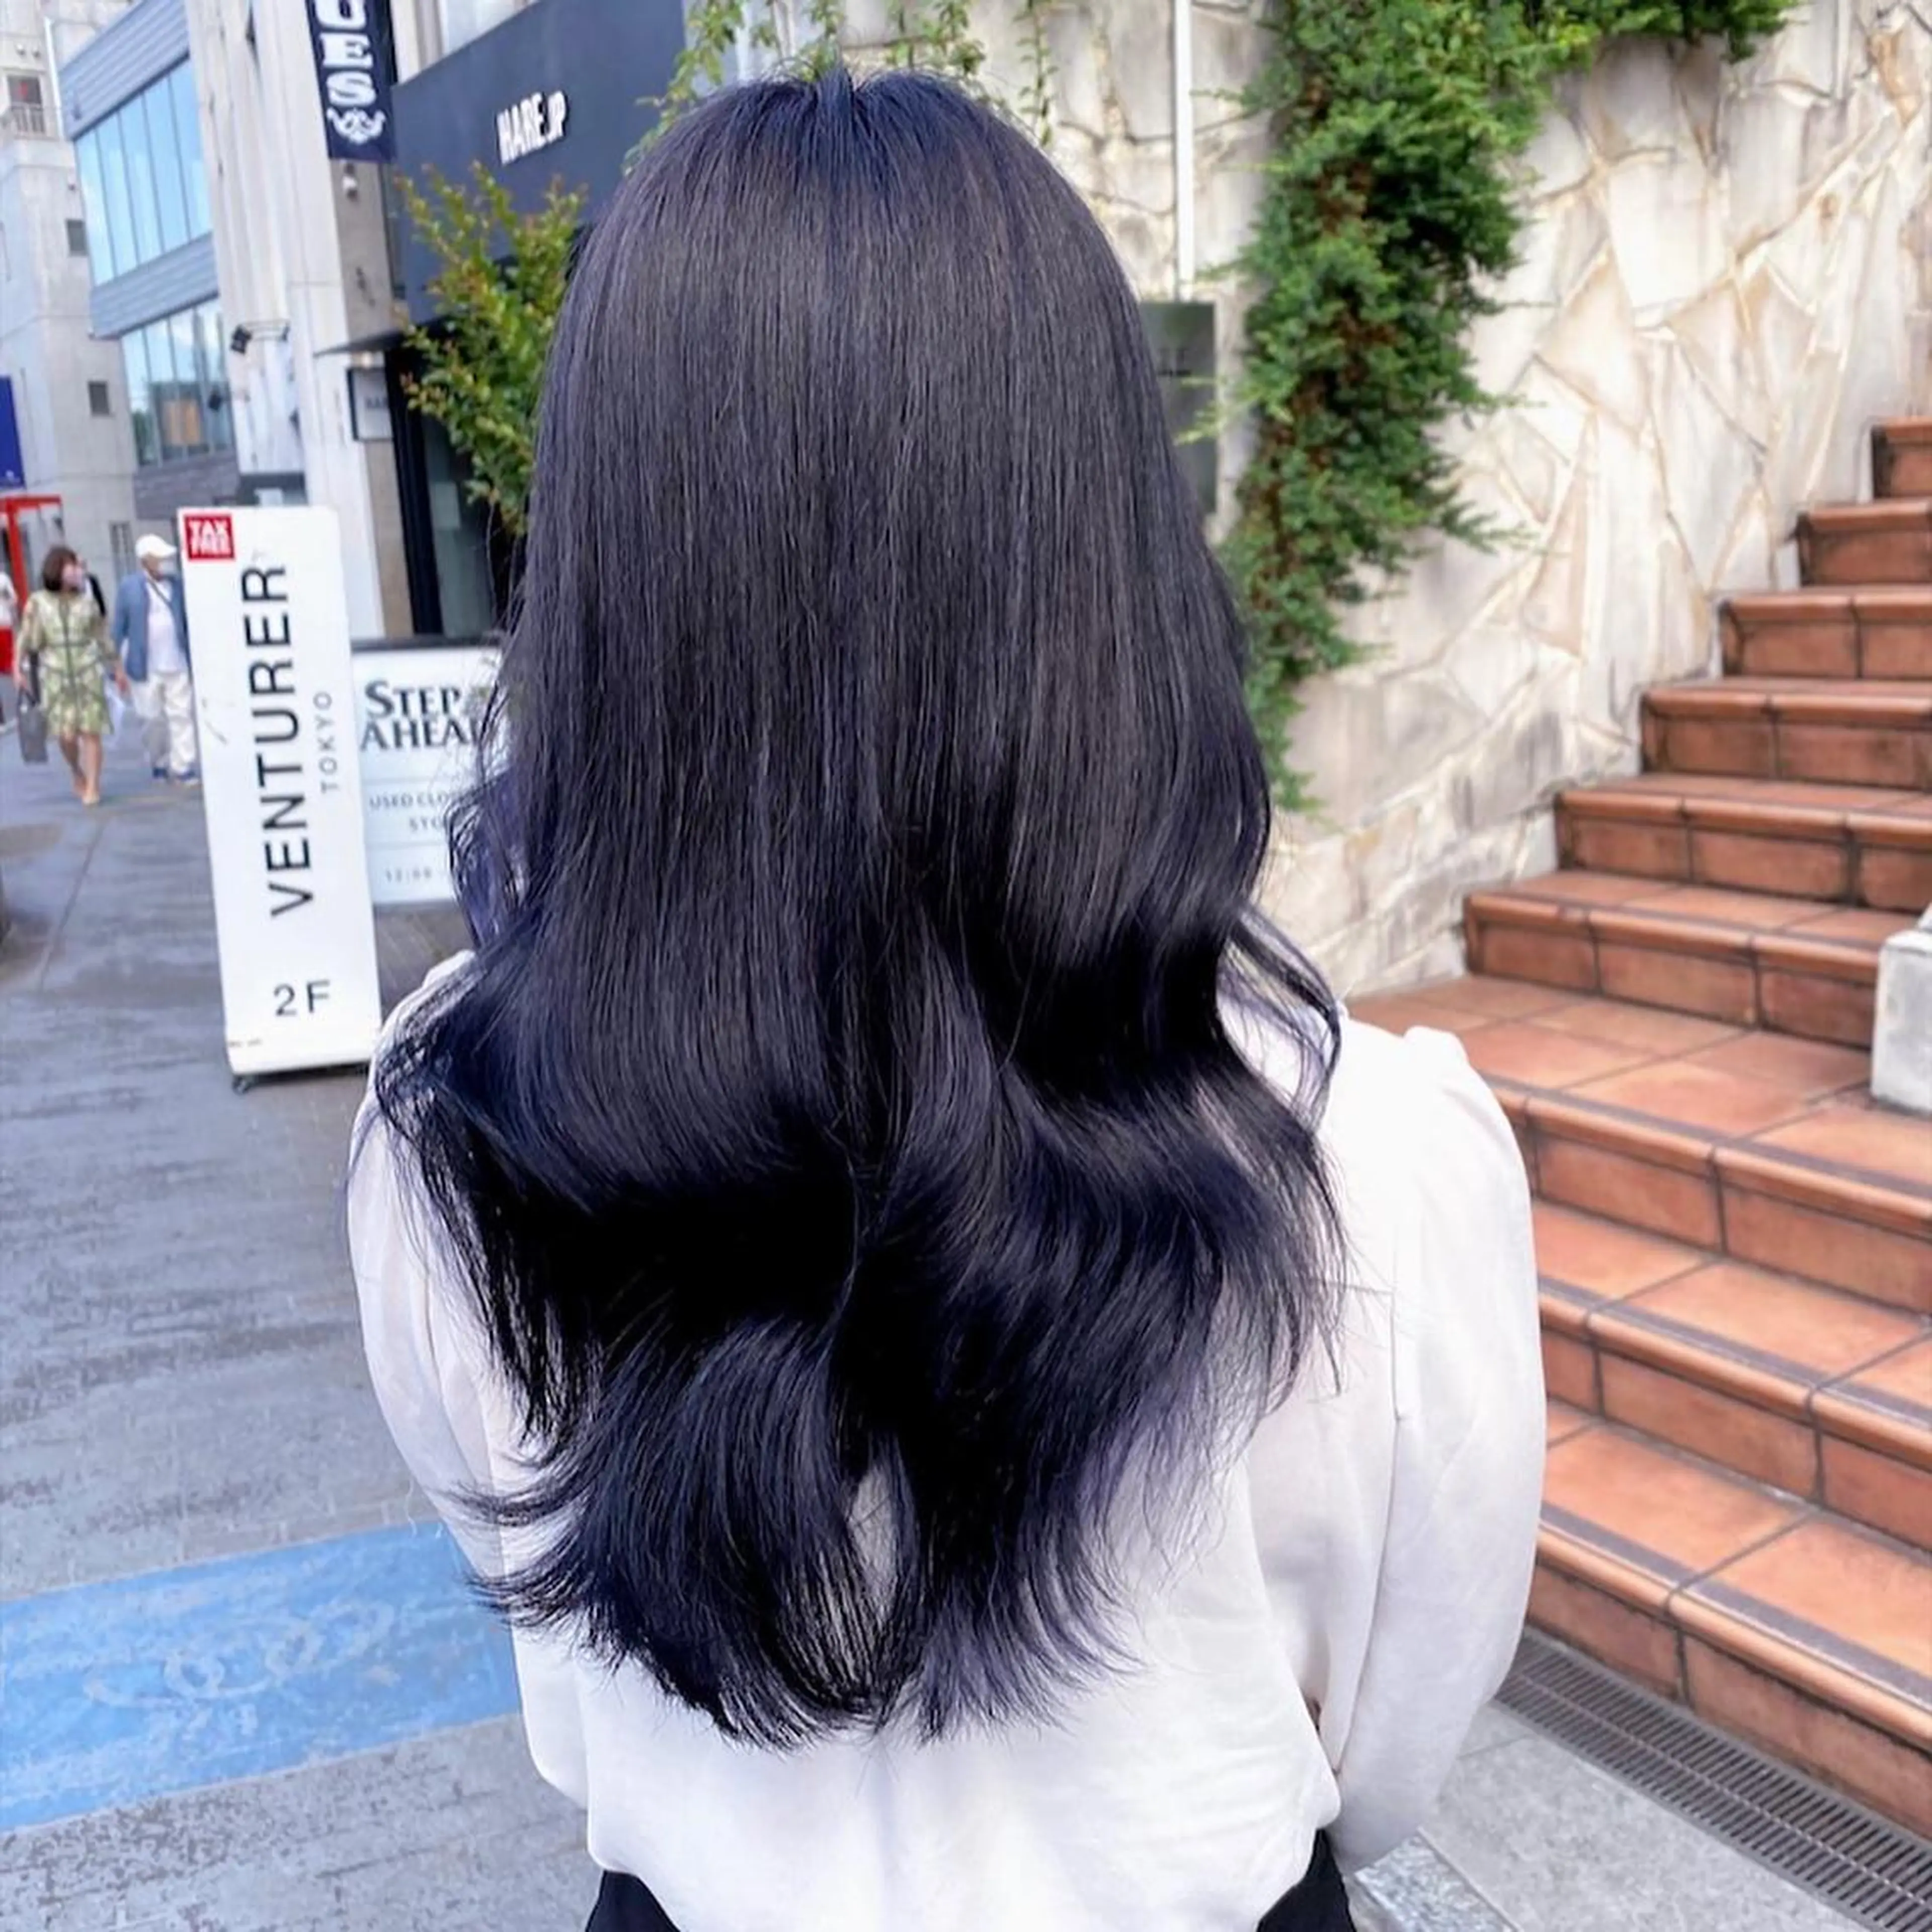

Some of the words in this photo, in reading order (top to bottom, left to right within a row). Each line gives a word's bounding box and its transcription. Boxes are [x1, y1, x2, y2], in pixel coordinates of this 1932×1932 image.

[241, 565, 313, 918] VENTURER
[312, 691, 339, 794] TOKYO
[273, 979, 331, 1017] 2F
